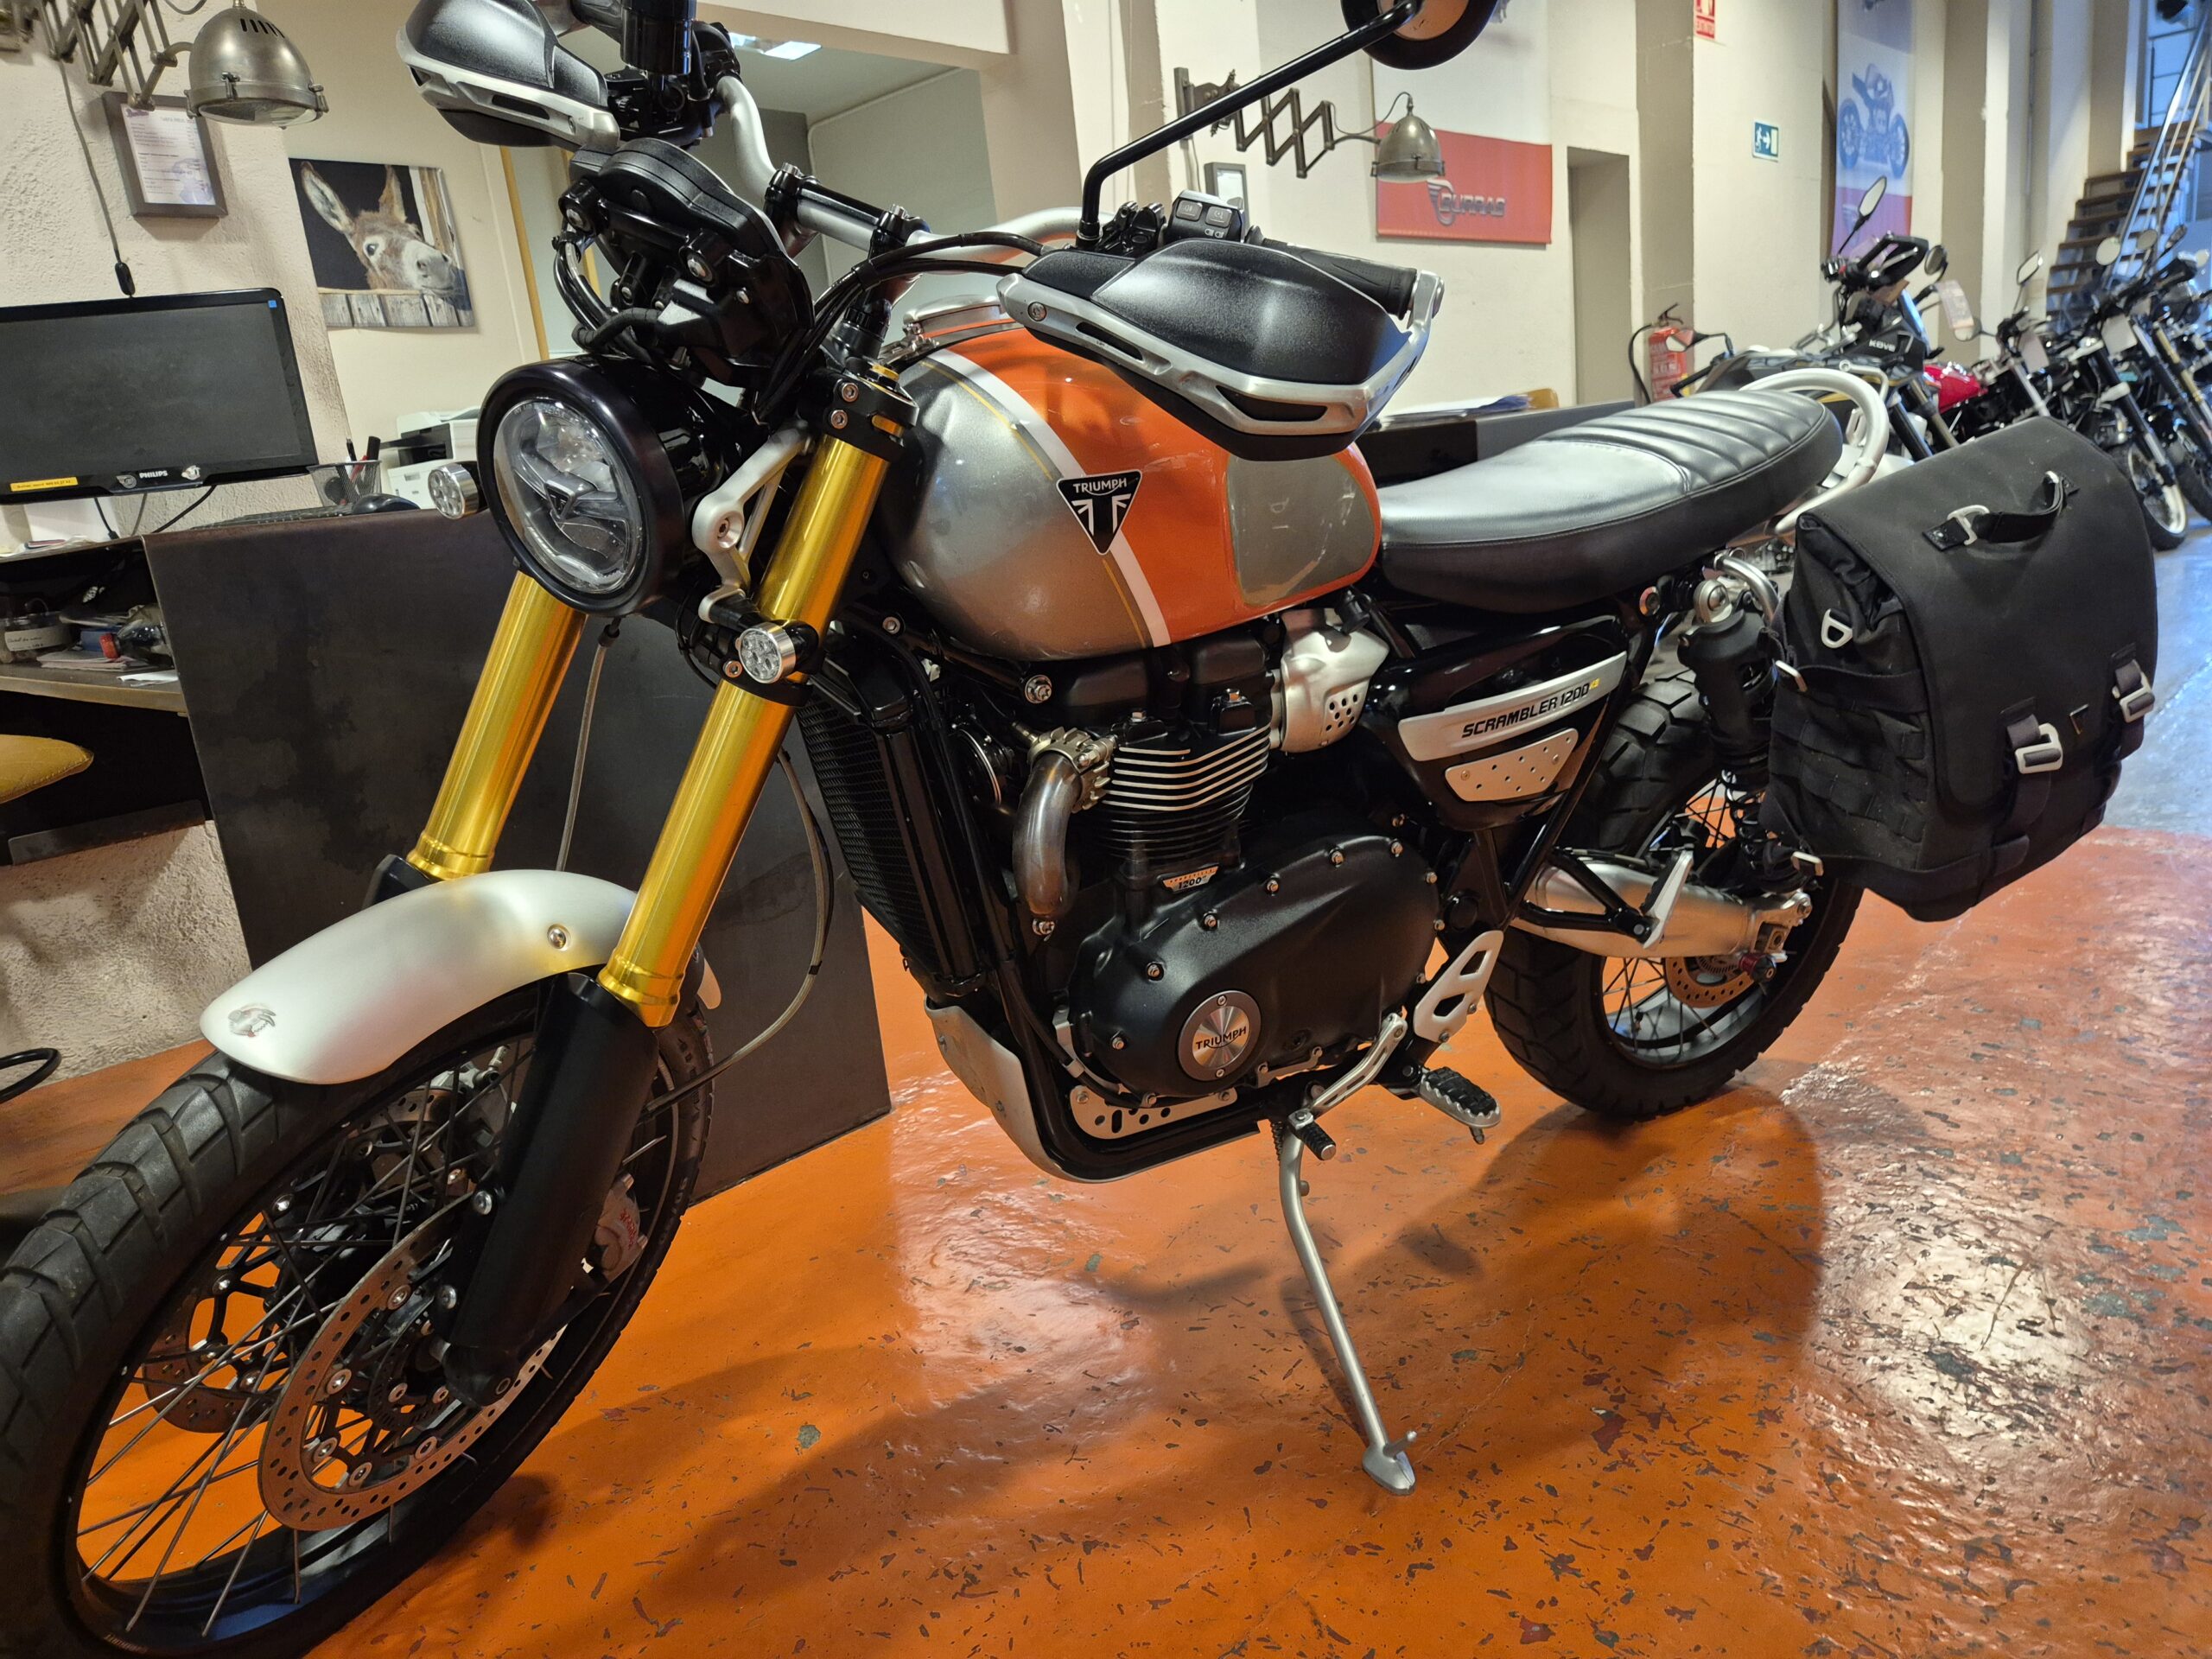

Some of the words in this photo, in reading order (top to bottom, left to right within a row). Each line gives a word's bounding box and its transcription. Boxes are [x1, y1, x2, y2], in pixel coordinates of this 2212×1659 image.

[1868, 339, 1896, 353] KOVE
[139, 470, 168, 480] PHILIPS
[1072, 477, 1128, 496] TRIUMPH
[1461, 696, 1558, 738] SCRAMBLER
[1559, 683, 1591, 707] 1200
[1195, 1026, 1247, 1050] TRIUMPH
